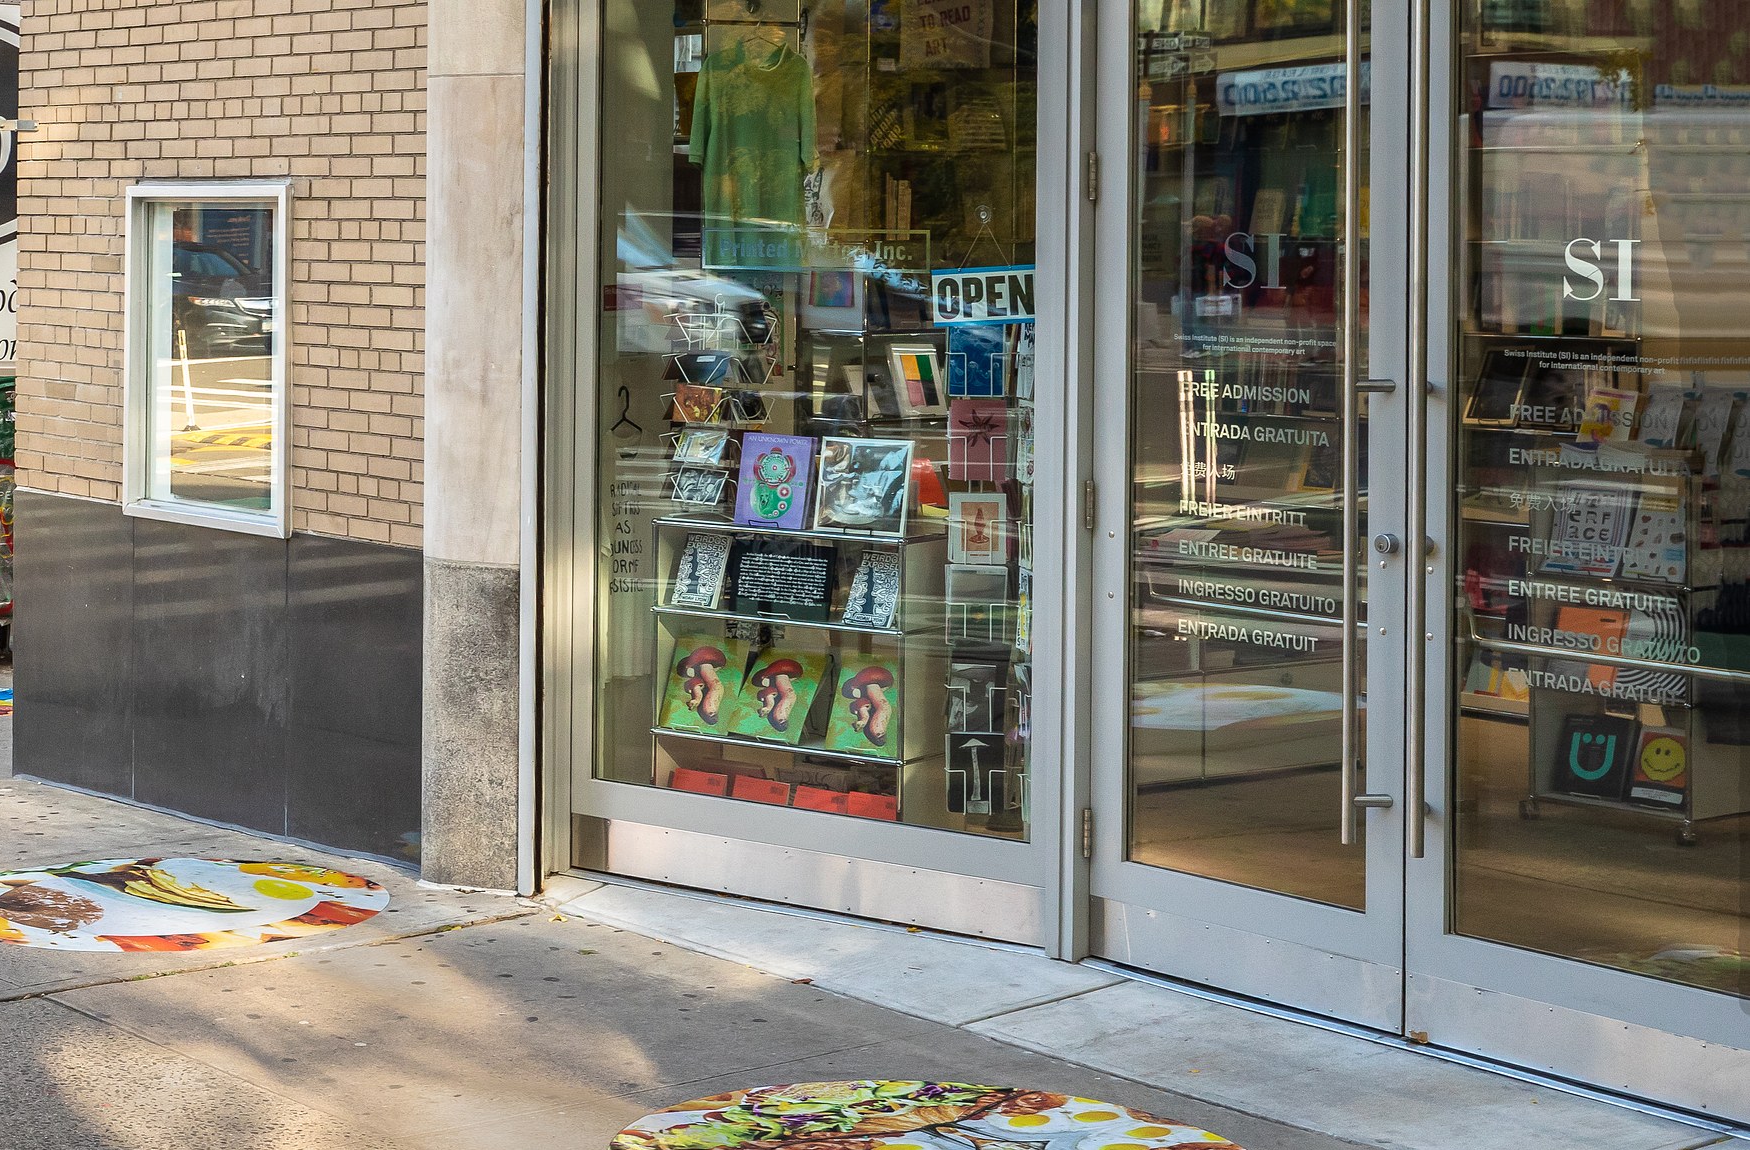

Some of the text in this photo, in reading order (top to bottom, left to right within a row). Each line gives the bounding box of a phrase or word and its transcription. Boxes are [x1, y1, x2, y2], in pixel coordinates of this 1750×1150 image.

[719, 239, 789, 259] Printed
[874, 240, 913, 261] Inc.
[1223, 232, 1287, 289] SI
[1563, 238, 1641, 301] SI
[937, 274, 1035, 319] OPEN
[1174, 333, 1191, 341] Swiss
[1218, 335, 1229, 343] (SI)
[1245, 336, 1283, 345] independent
[1284, 338, 1317, 346] non-profit
[1317, 340, 1336, 348] space
[1212, 344, 1251, 352] international
[1251, 347, 1295, 356] contemporary
[1504, 349, 1525, 358] Swiss
[1526, 351, 1557, 359] Institute
[1558, 351, 1571, 360] (SI)
[1572, 352, 1579, 360] is
[1590, 353, 1638, 363] independent
[1639, 357, 1680, 366] non-profit
[1539, 361, 1665, 375] for international contemporary art
[1183, 382, 1310, 404] FREE ADMISSION
[1509, 404, 1556, 423] FREE
[1184, 421, 1329, 447] ENTRADA GRATUITA
[1509, 447, 1595, 470] ENTRADA
[1179, 499, 1306, 528] FREIER EINTRITT
[1509, 492, 1577, 514] 免费入场
[687, 542, 725, 552] EXPOSED
[689, 534, 727, 546] WEIRDOS
[863, 552, 898, 564] WEIRDO
[1179, 540, 1317, 570] ENTREE GRATUITE
[1178, 579, 1336, 613] INGRESSO GRATUITO
[1508, 580, 1678, 615] ENTREE GRATUITE
[1178, 619, 1318, 652] ENTRADA GRATUIT
[1508, 623, 1602, 651] INGRESSO
[1508, 667, 1678, 706] ENTRADA GRATUIT
